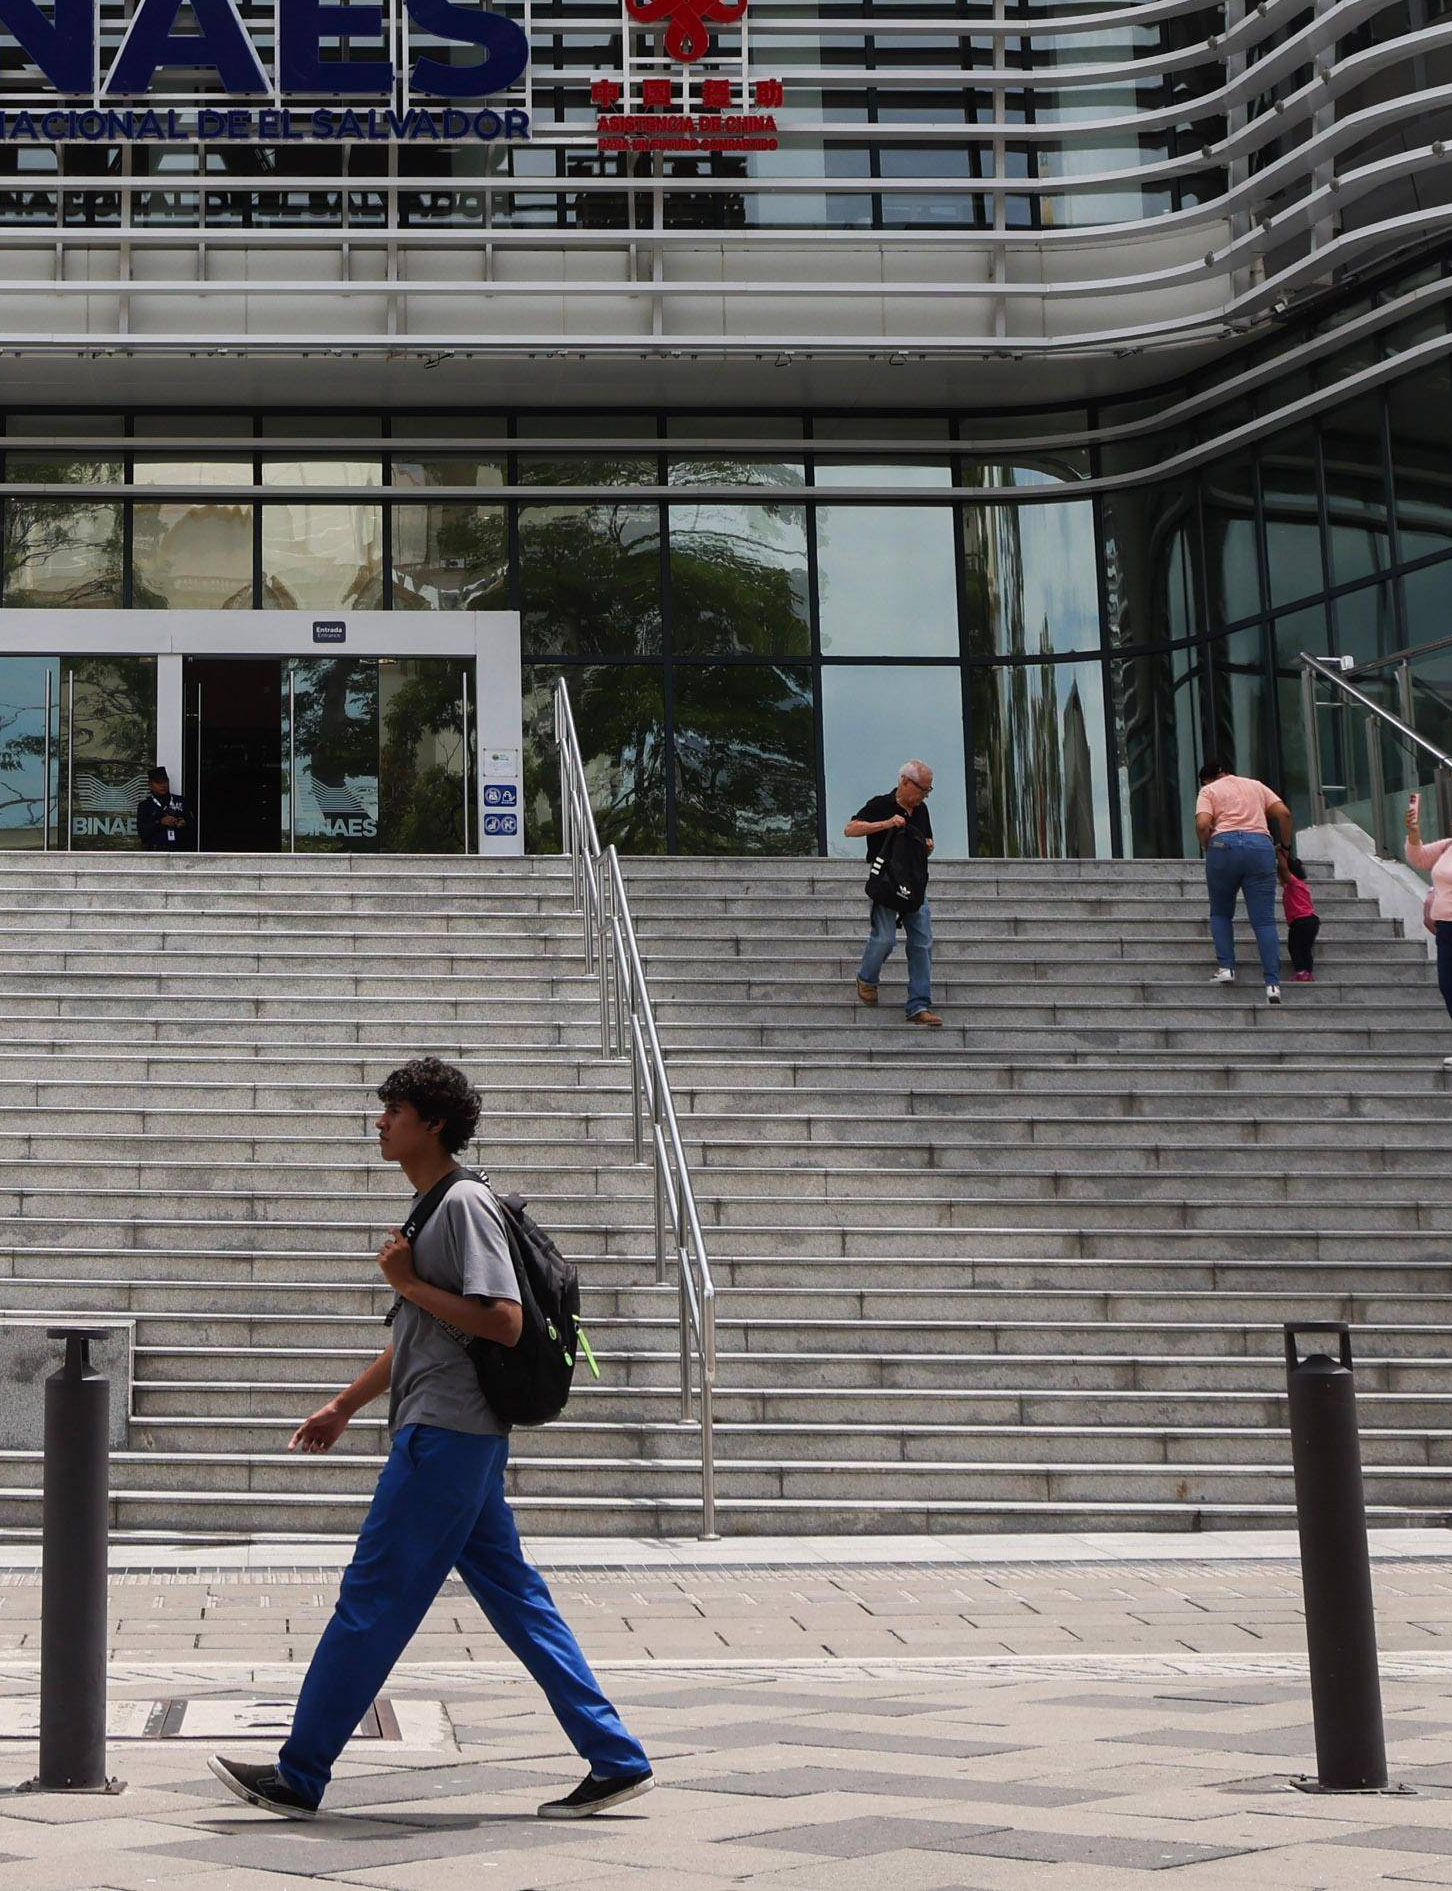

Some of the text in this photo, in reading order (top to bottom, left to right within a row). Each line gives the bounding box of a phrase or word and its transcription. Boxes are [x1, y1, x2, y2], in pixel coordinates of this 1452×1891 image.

[198, 109, 250, 140] DE
[258, 109, 304, 140] EL
[311, 109, 531, 141] SALVADOR
[597, 115, 778, 133] ASISTENCIA DE CHINA
[699, 138, 779, 151] COMPARTIDO
[72, 817, 138, 836] BINAE
